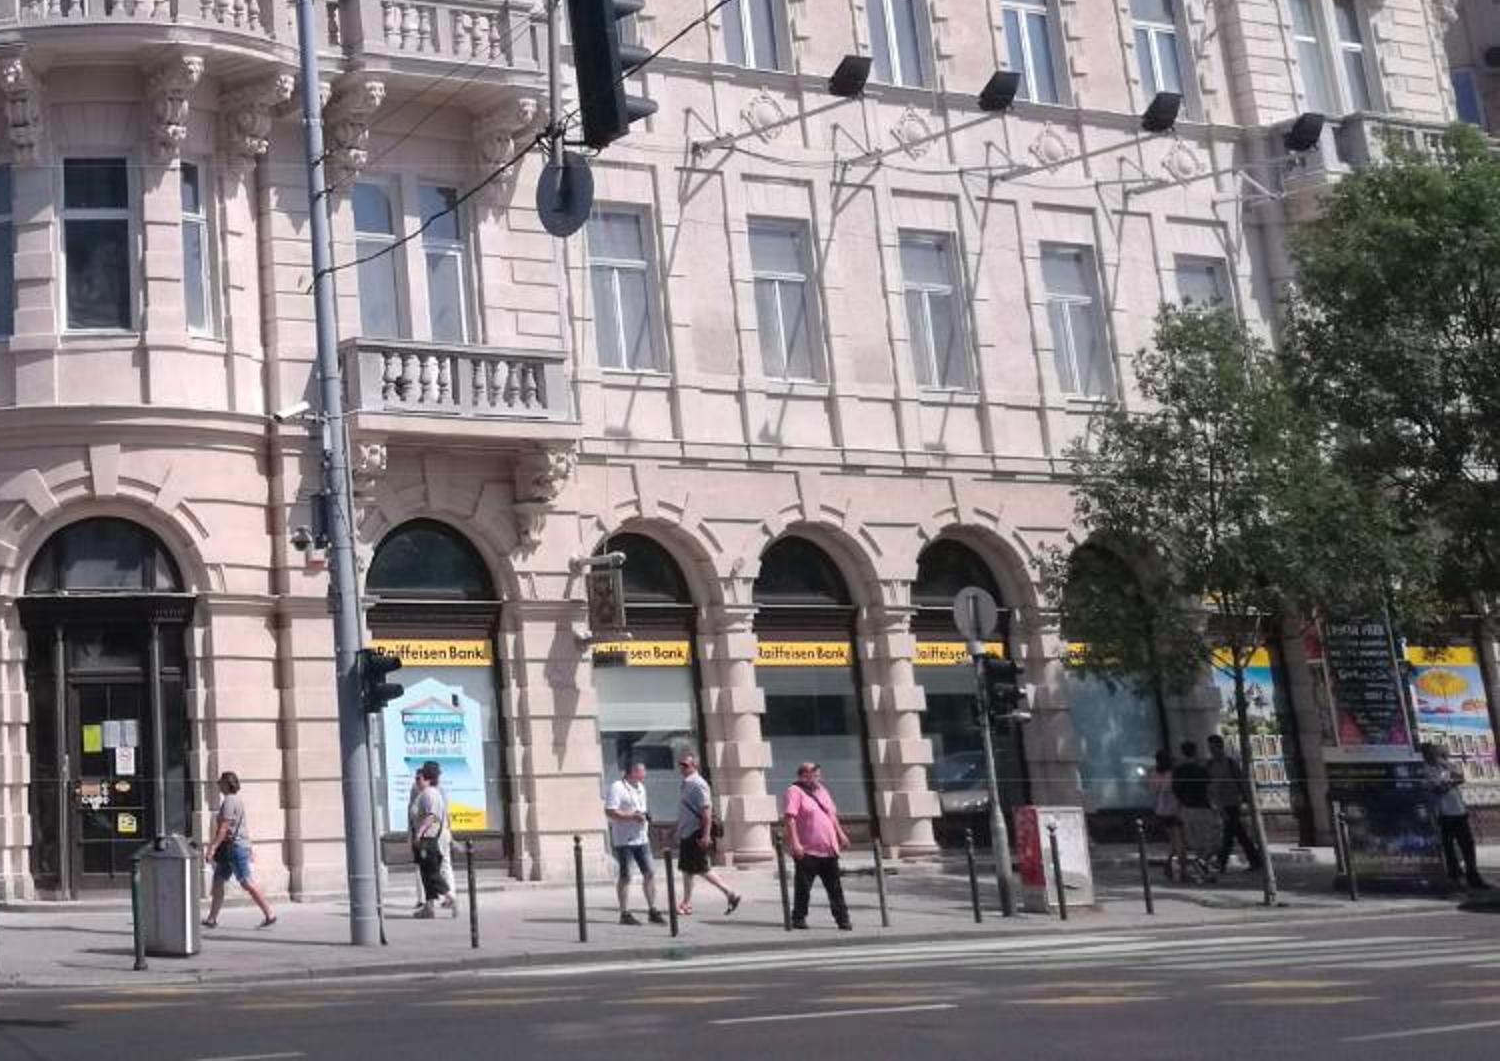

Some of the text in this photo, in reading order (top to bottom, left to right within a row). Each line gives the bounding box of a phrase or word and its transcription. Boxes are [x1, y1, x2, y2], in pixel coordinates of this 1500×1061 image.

[449, 645, 484, 660] Bank
[653, 645, 684, 660] Bank
[817, 646, 845, 659] Bank
